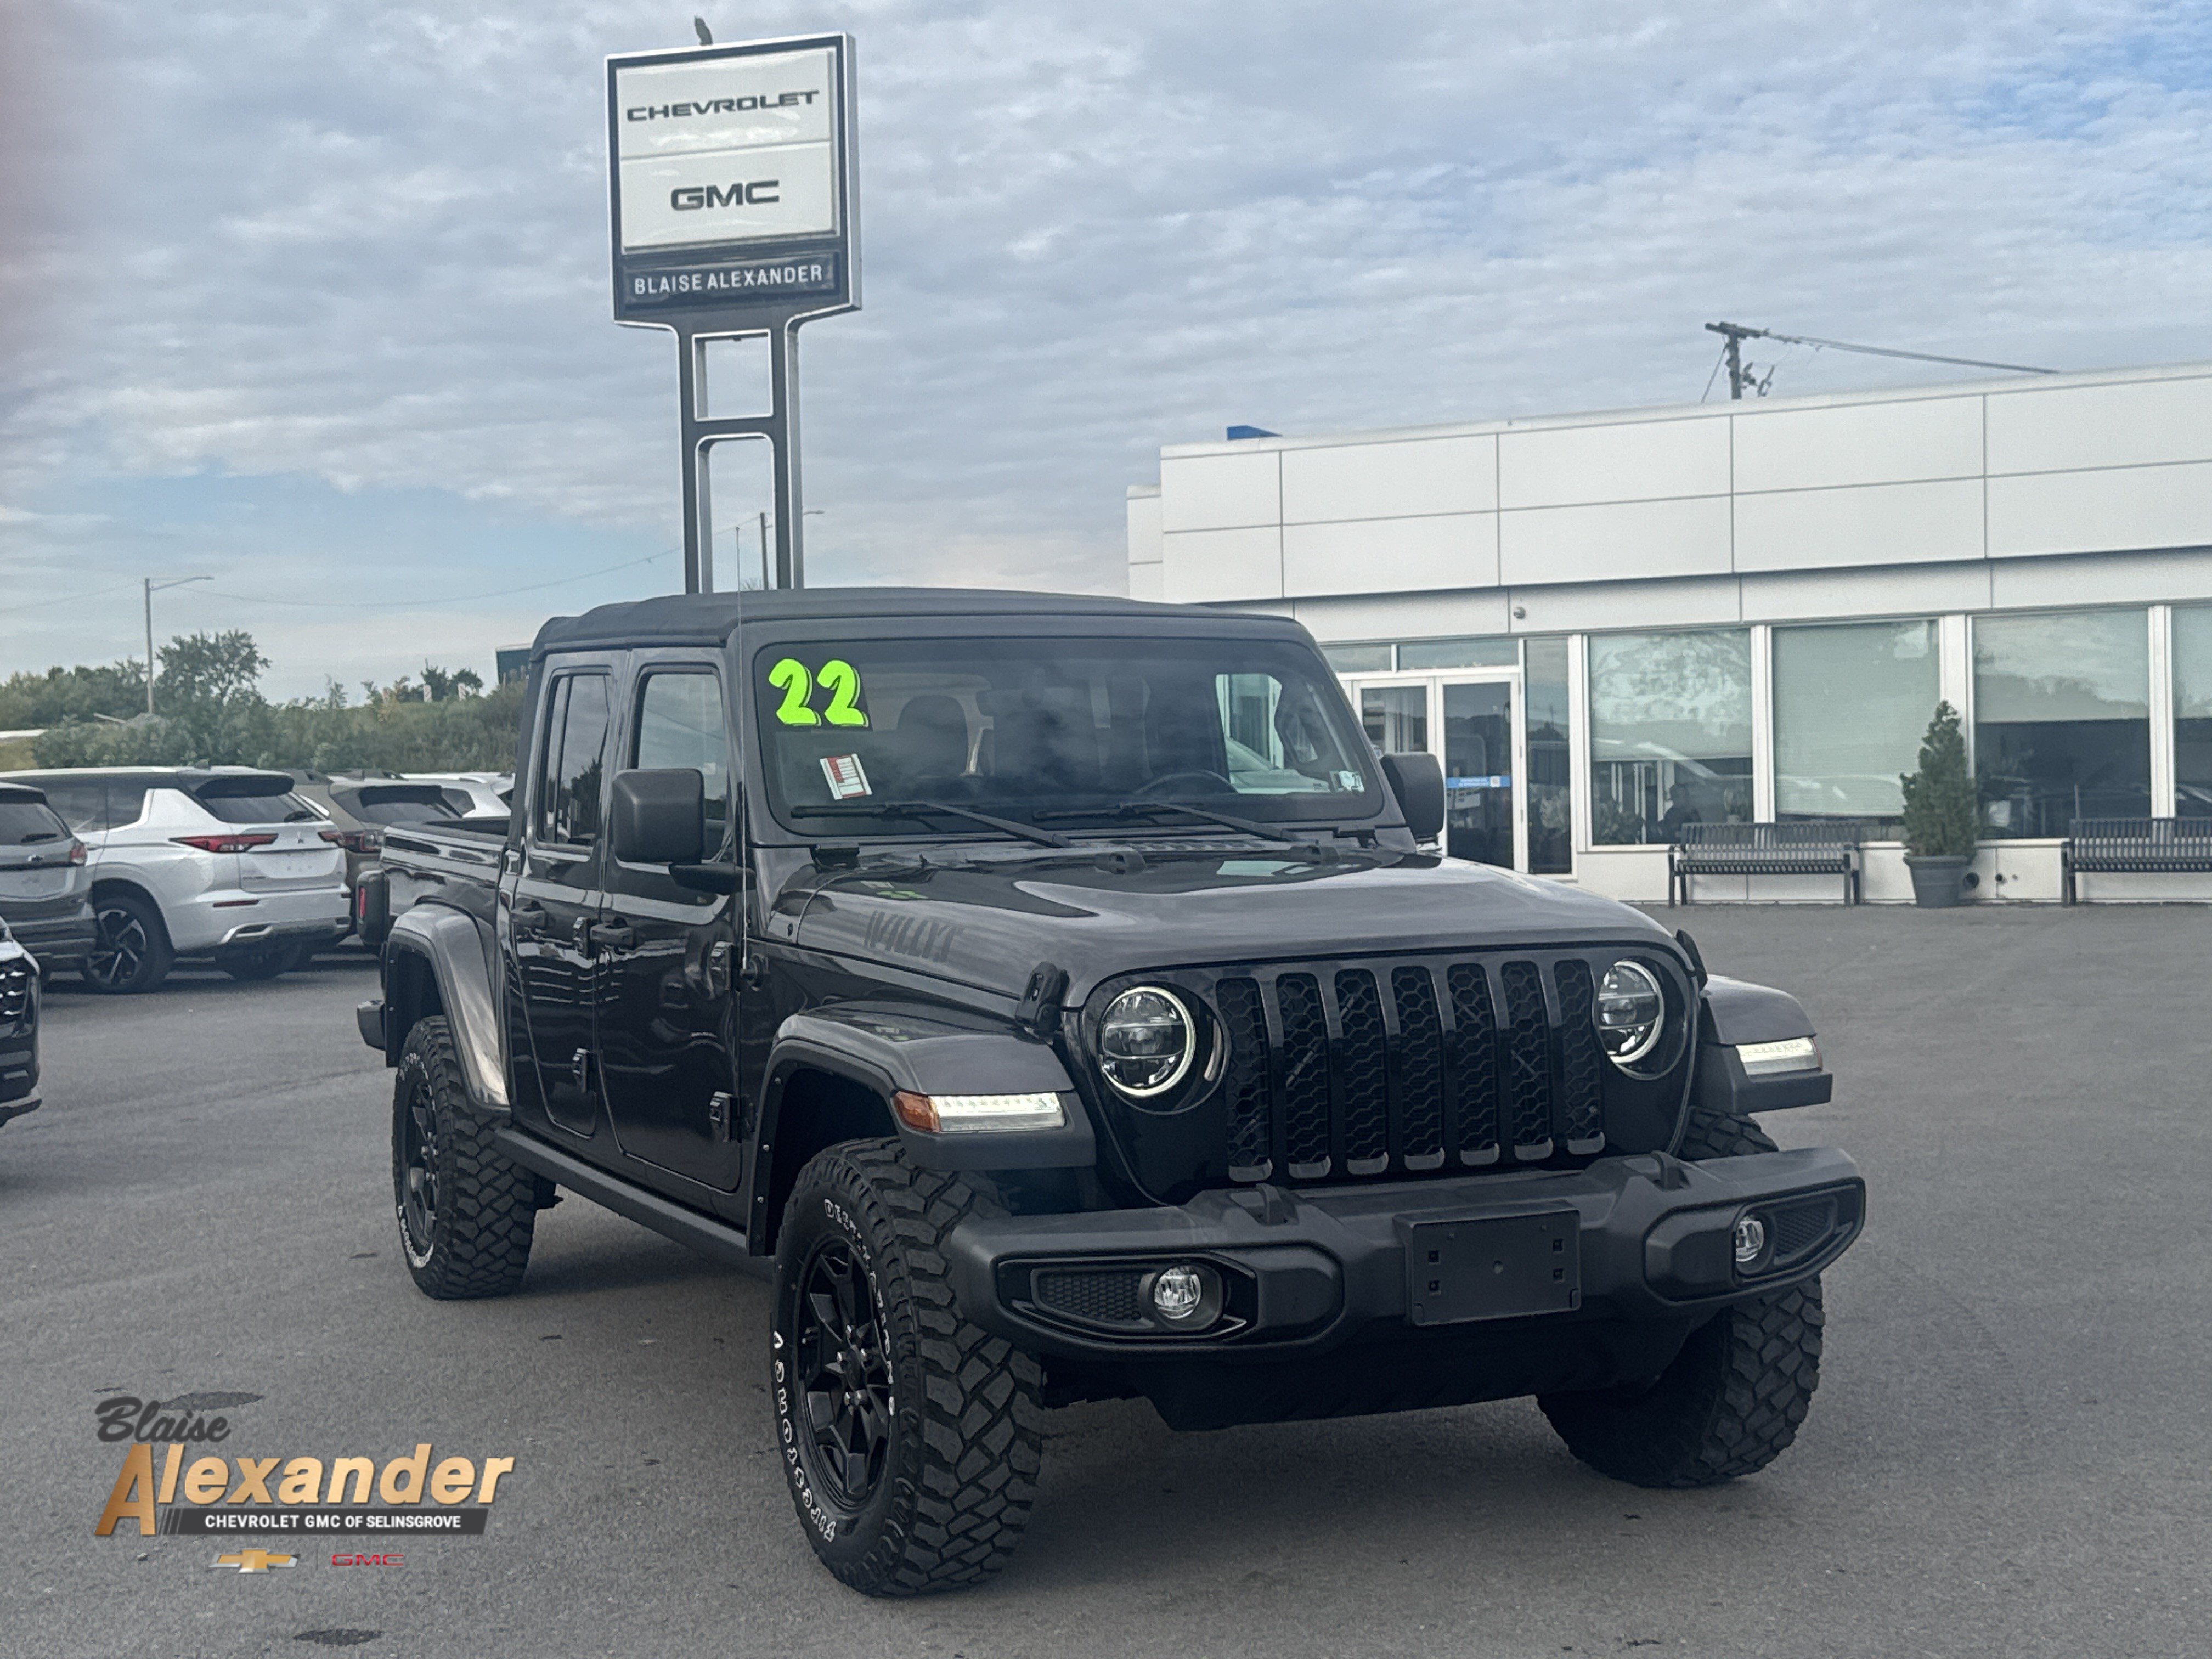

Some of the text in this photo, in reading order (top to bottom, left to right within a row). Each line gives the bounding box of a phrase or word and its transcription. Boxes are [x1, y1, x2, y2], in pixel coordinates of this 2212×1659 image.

[627, 90, 820, 122] CHEVROLET
[670, 180, 780, 211] GMC
[634, 264, 823, 295] BLAISE ALEXANDER
[768, 658, 867, 726] 22
[864, 910, 964, 962] WILLYS
